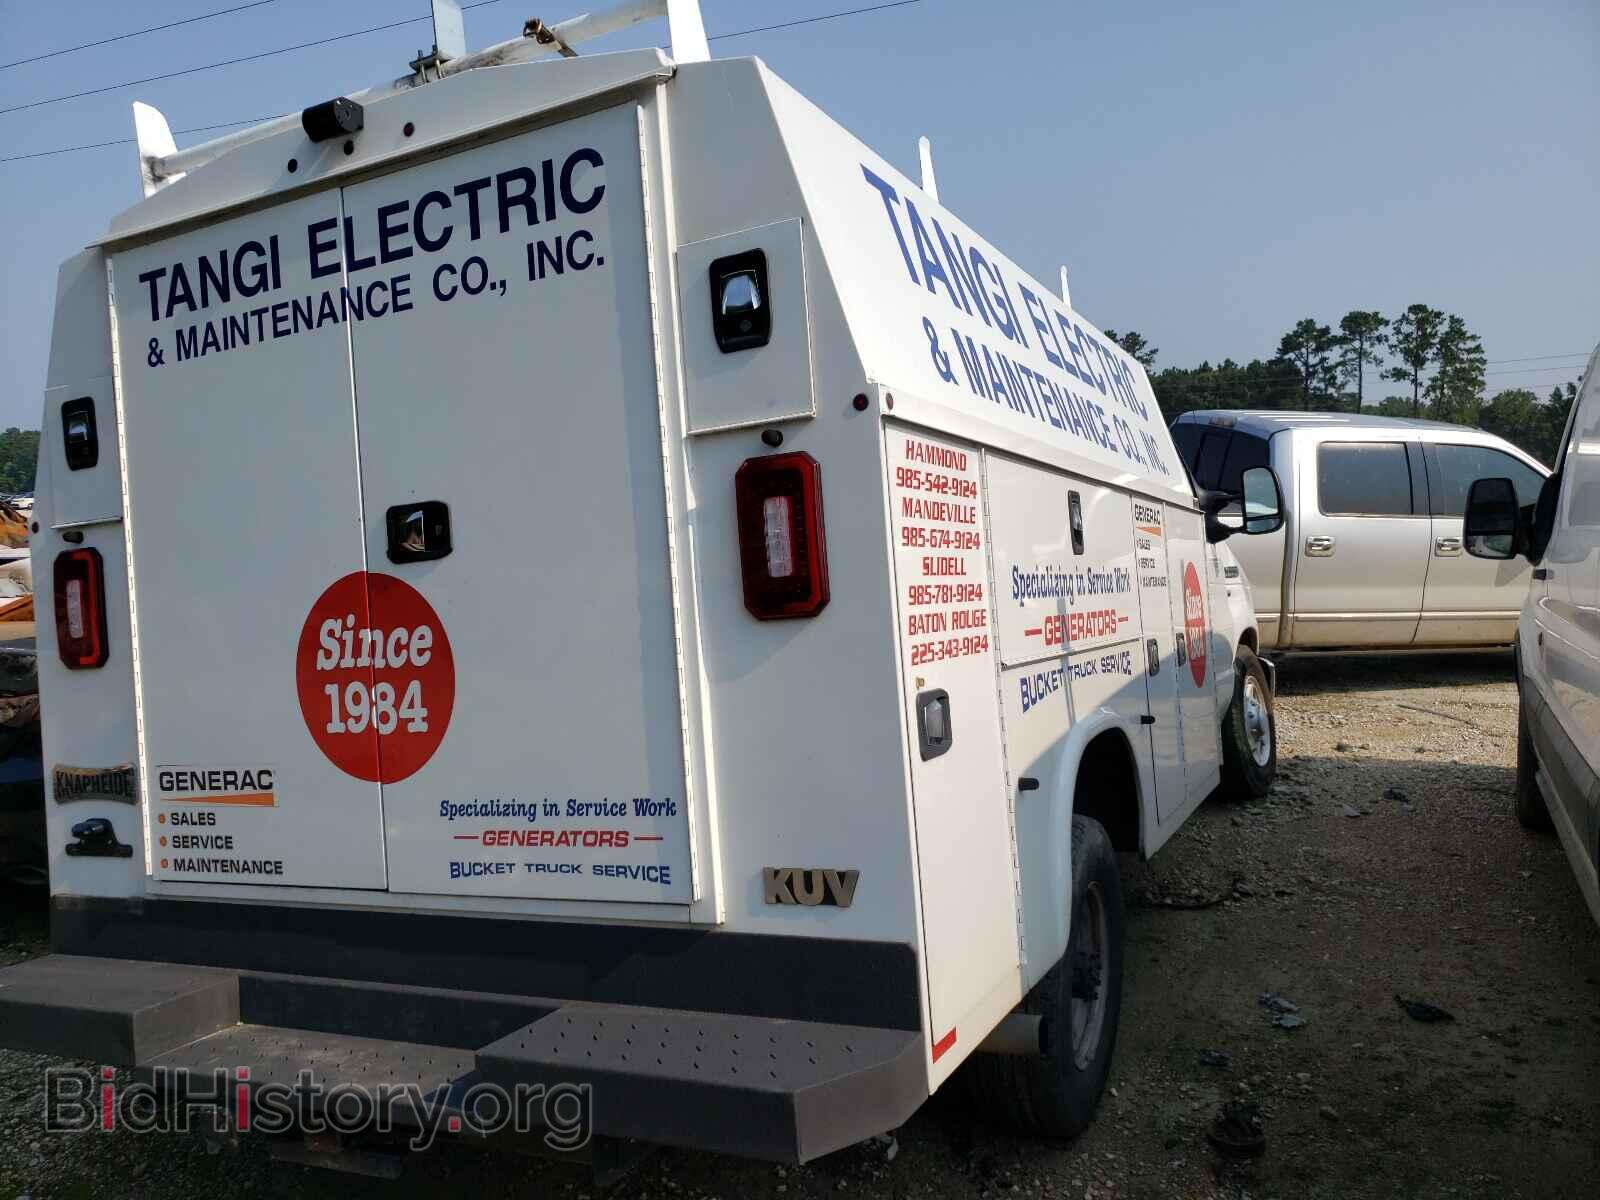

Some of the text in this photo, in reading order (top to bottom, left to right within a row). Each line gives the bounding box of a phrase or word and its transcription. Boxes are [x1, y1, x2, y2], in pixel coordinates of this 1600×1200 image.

[139, 148, 606, 321] TANGI ELECTRIC
[147, 230, 605, 368] & MAINTENANCE CO., INC.
[859, 163, 1149, 421] TANGI ELECTRIC
[922, 316, 960, 386] &
[950, 327, 1118, 453] MAINTENANCE
[905, 439, 967, 472] HAMMOND
[896, 466, 977, 499] 985-542-9124
[902, 497, 976, 524] MANDEVILLE
[1134, 503, 1161, 526] GENERAC
[901, 526, 981, 550] 985-674-9124
[922, 556, 967, 576] SLIDELL
[908, 584, 983, 606] 985-781-9124
[1012, 565, 1131, 607] Specializing in Service Work
[908, 608, 987, 636] BATON ROUGE
[1044, 609, 1117, 646] GENERATORS
[316, 613, 433, 671] Since
[911, 634, 989, 666] 225-343-9124
[1020, 651, 1132, 713] BUCKET TRUCK SERVICE
[324, 679, 428, 735] 1984
[159, 769, 274, 792] GENERAC
[171, 812, 216, 826] SALES
[439, 798, 677, 822] Specializing in Service Work
[172, 836, 233, 850] SERVICE
[482, 830, 629, 848] GENERATORS
[173, 858, 283, 875] MAINTENANCE
[449, 861, 671, 885] BUCKET TRUCK SERVICE
[763, 866, 859, 908] KUV
